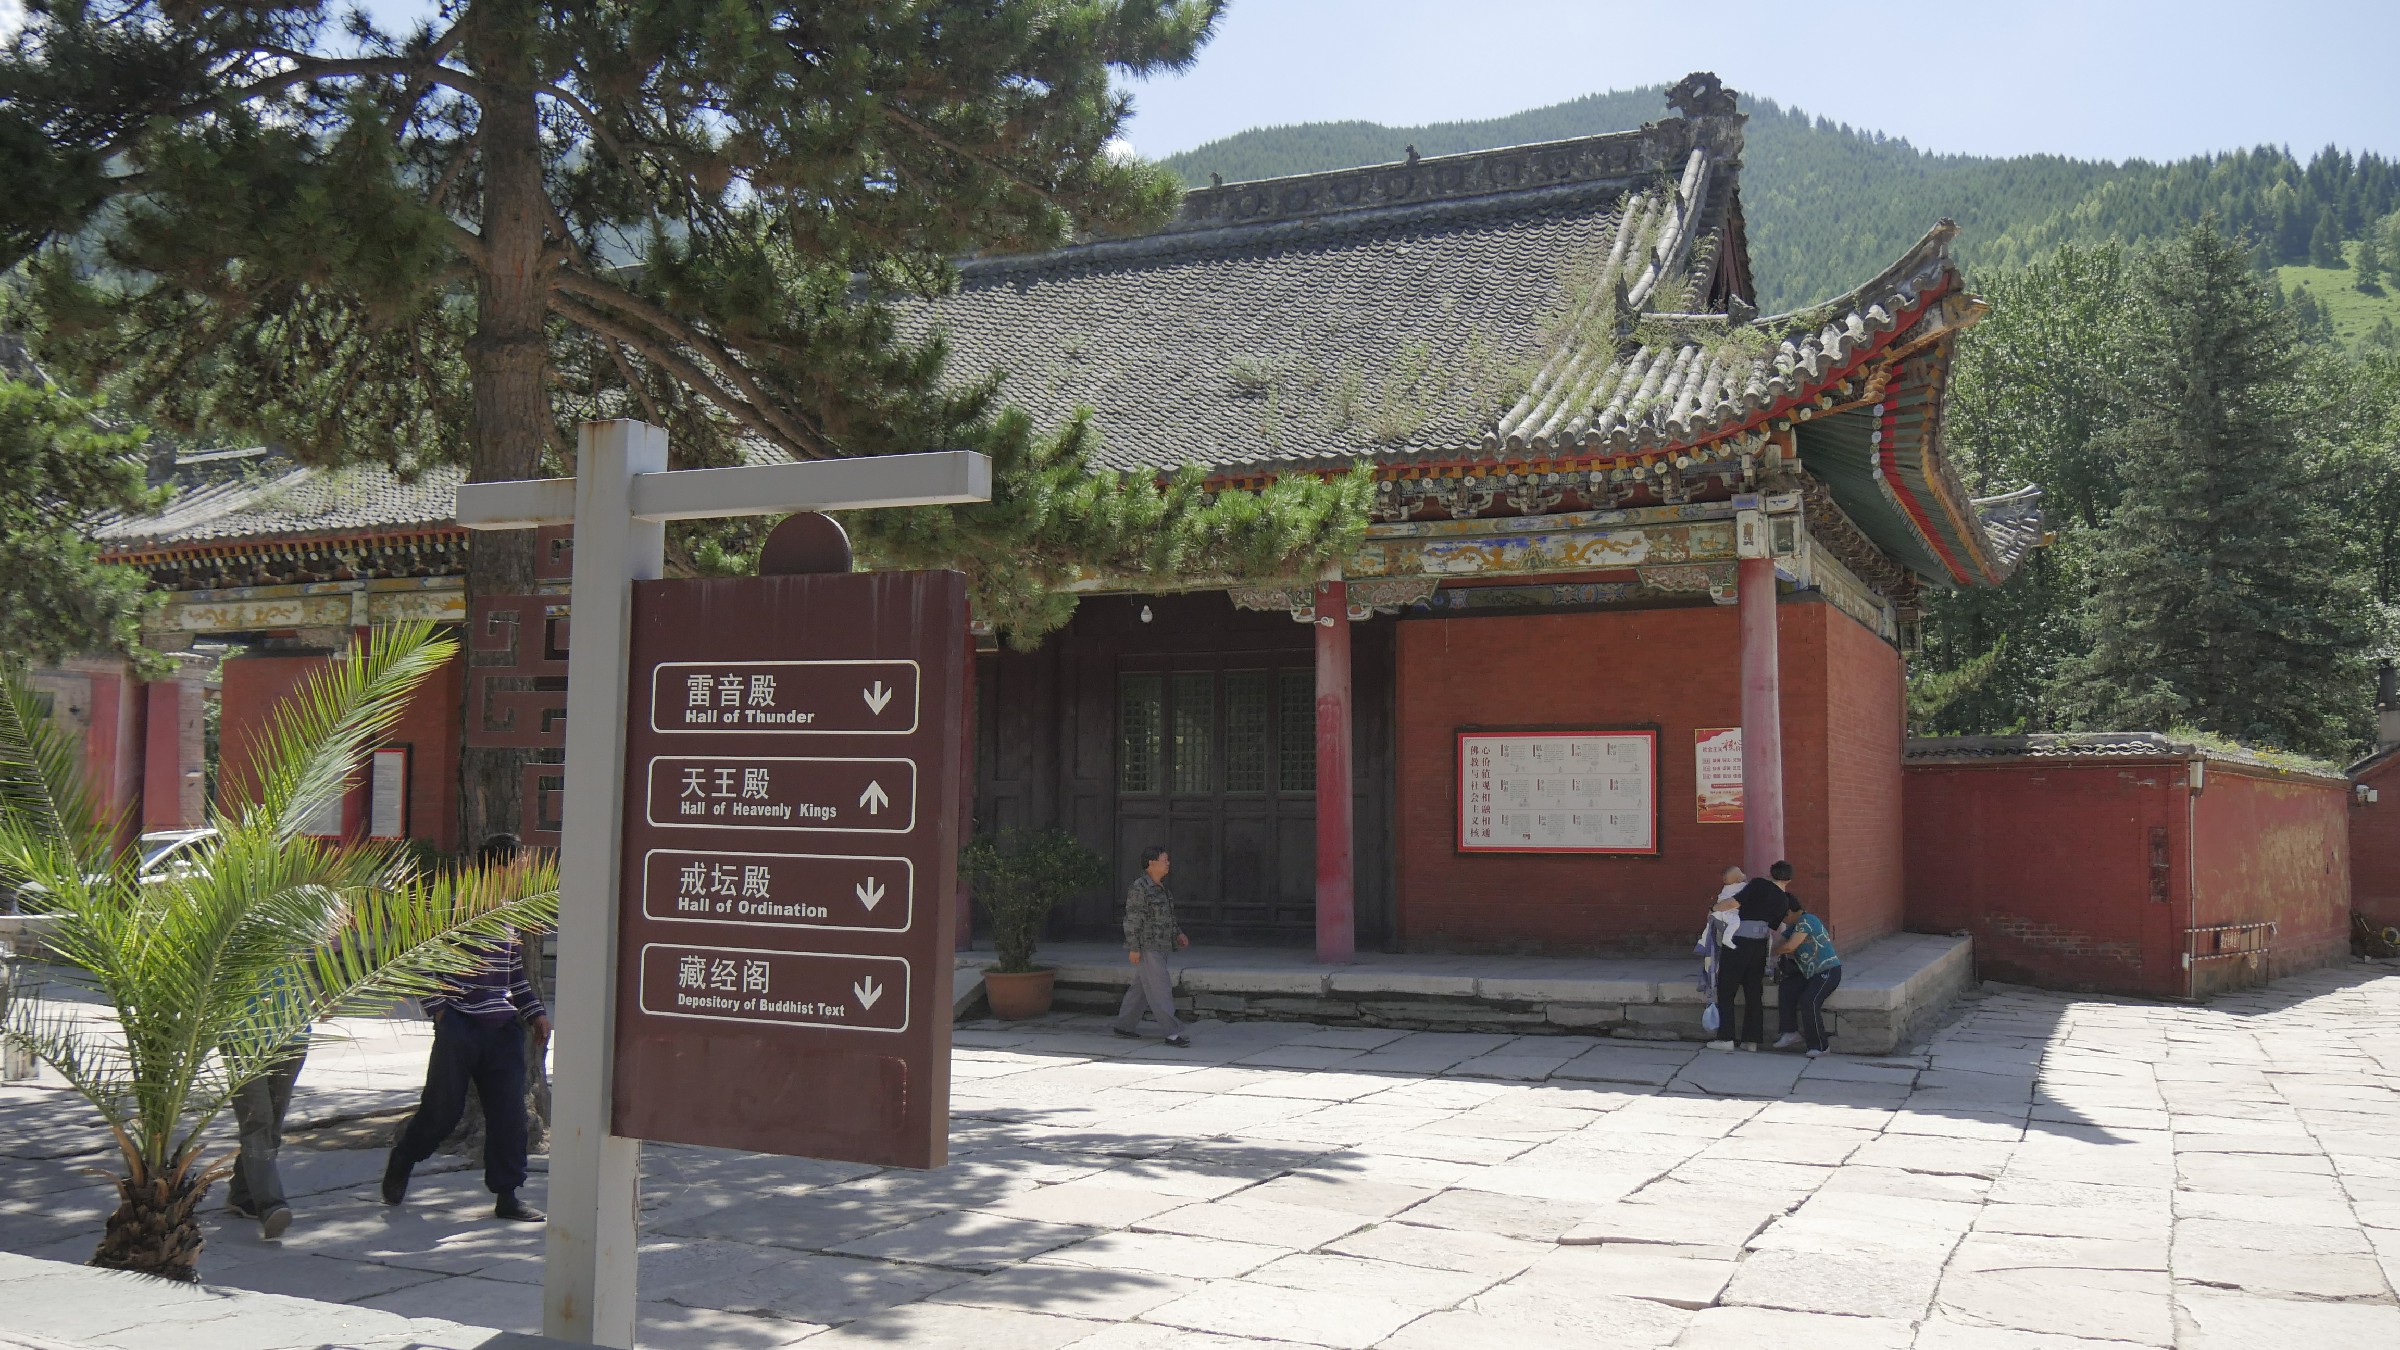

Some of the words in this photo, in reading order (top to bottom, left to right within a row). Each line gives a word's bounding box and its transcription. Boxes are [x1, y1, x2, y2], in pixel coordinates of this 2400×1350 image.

[687, 672, 777, 707] 雷音殿
[685, 709, 718, 723] Hall
[723, 709, 741, 723] of
[744, 709, 815, 724] Thunder
[680, 768, 770, 800] 天王殿
[680, 801, 706, 815] Hall
[713, 801, 727, 816] of
[732, 802, 792, 820] Heavenly
[799, 803, 837, 821] Kings
[680, 861, 771, 899] 戒坛殿
[678, 896, 710, 912] Hall
[715, 899, 733, 913] of
[738, 900, 828, 918] Ordination
[678, 954, 770, 994] 藏经阁
[677, 992, 741, 1012] Depository
[743, 997, 757, 1011] of
[759, 998, 815, 1015] Buddhist
[817, 1002, 845, 1017] Text
